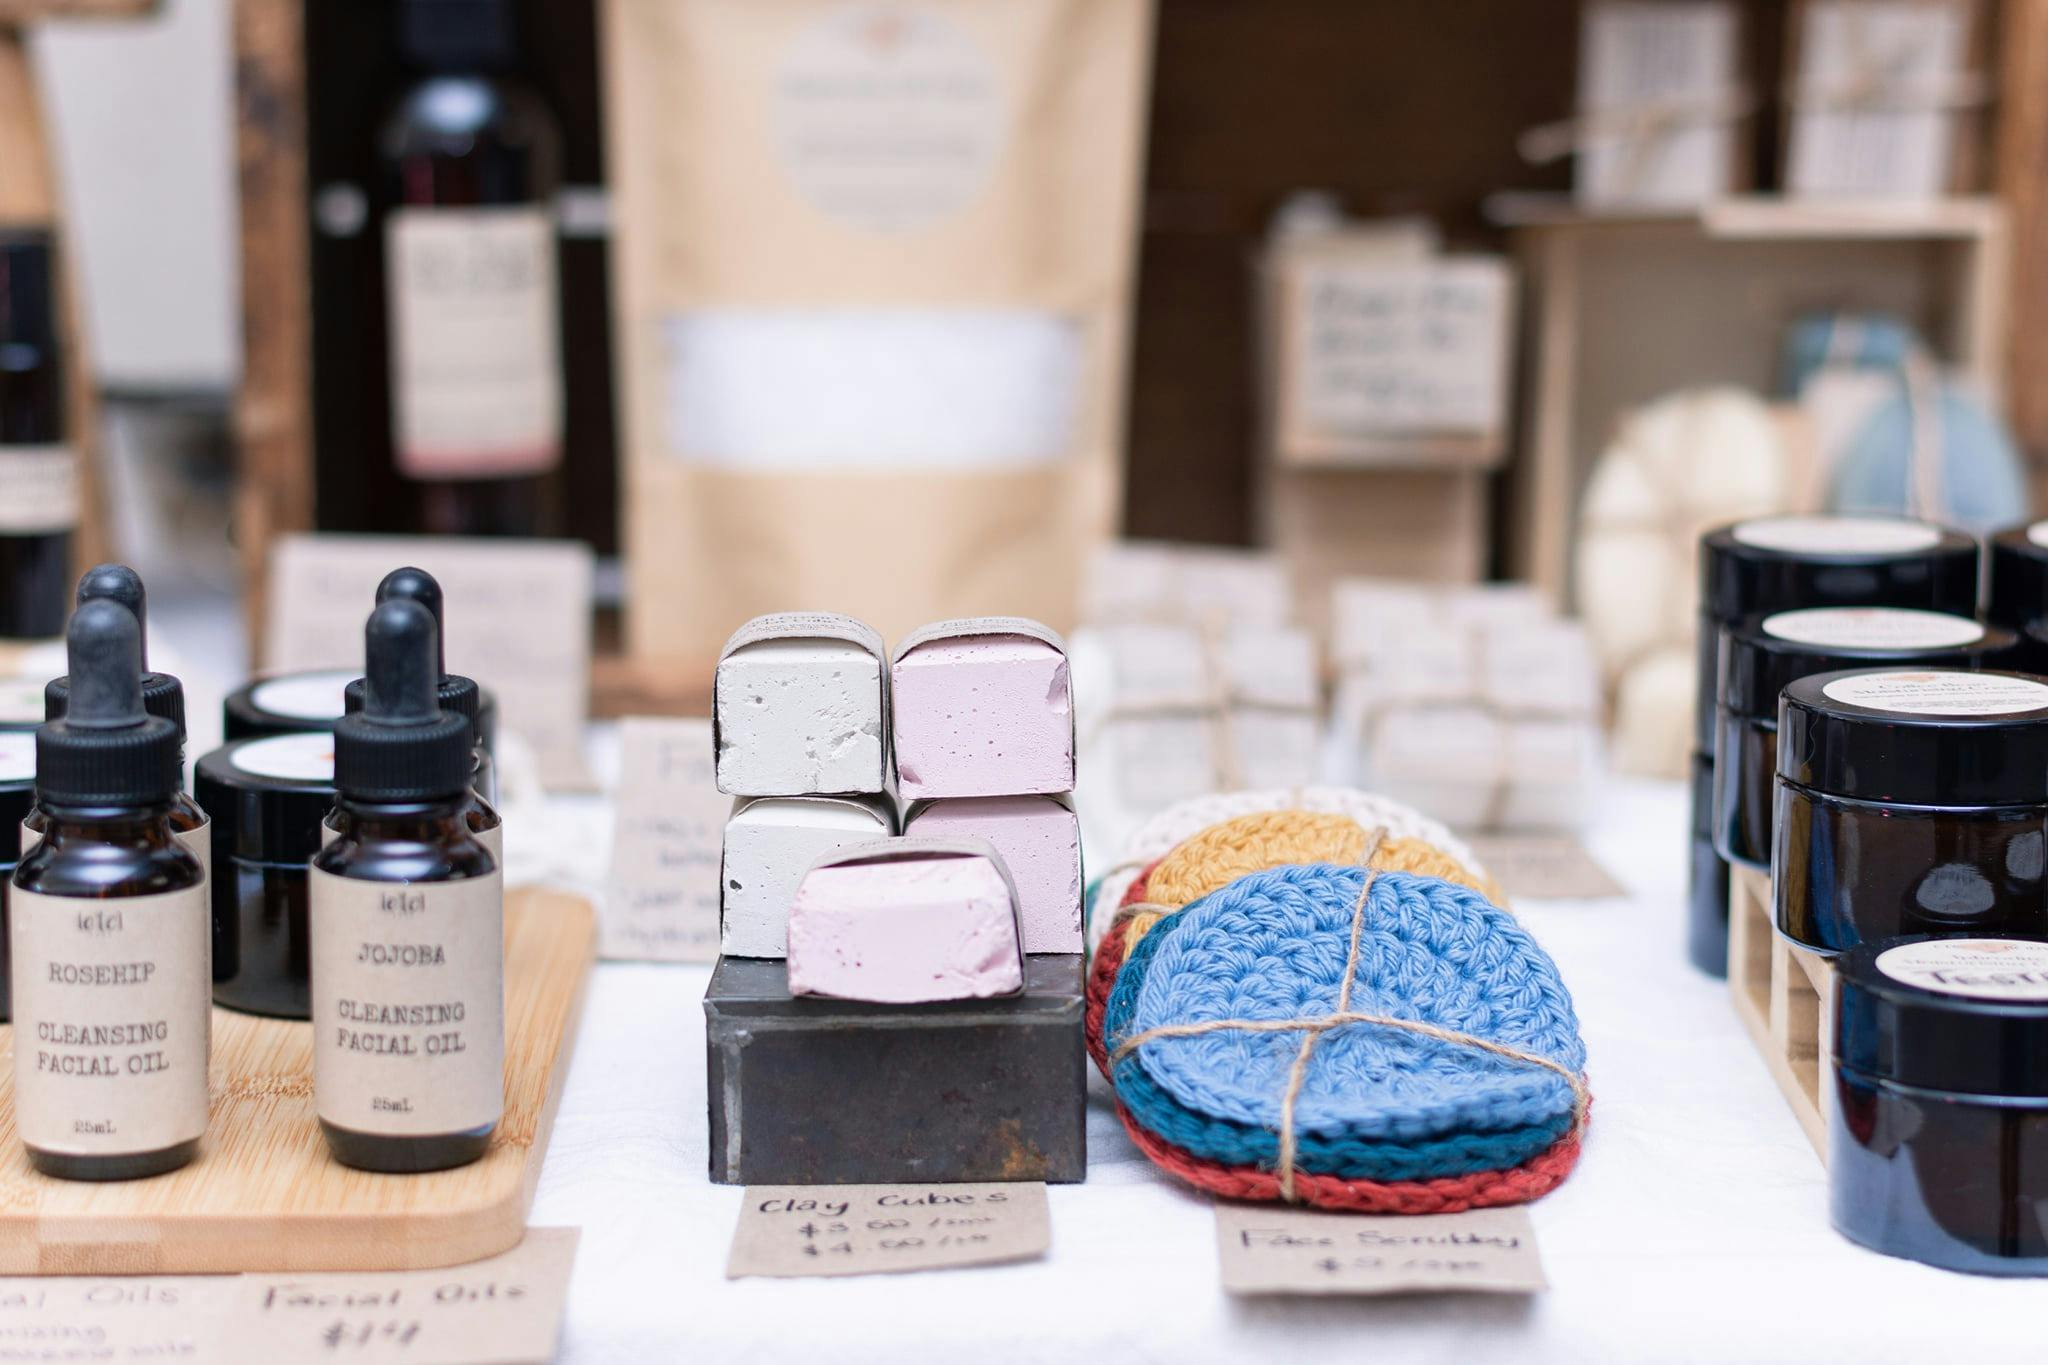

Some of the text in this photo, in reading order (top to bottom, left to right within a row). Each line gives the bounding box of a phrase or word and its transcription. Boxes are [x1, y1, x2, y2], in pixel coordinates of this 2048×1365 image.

[358, 943, 447, 966] JOJOBA
[49, 961, 156, 986] ROSEHIP
[338, 999, 466, 1024] CLEANSING
[37, 1021, 169, 1046] CLEANSING
[337, 1028, 466, 1055] FACIAL OIL
[37, 1051, 170, 1076] FACIAL OIL
[759, 1191, 1009, 1217] Clay Cubes
[1241, 1228, 1336, 1248] Face
[262, 1282, 526, 1311] Facial Oils
